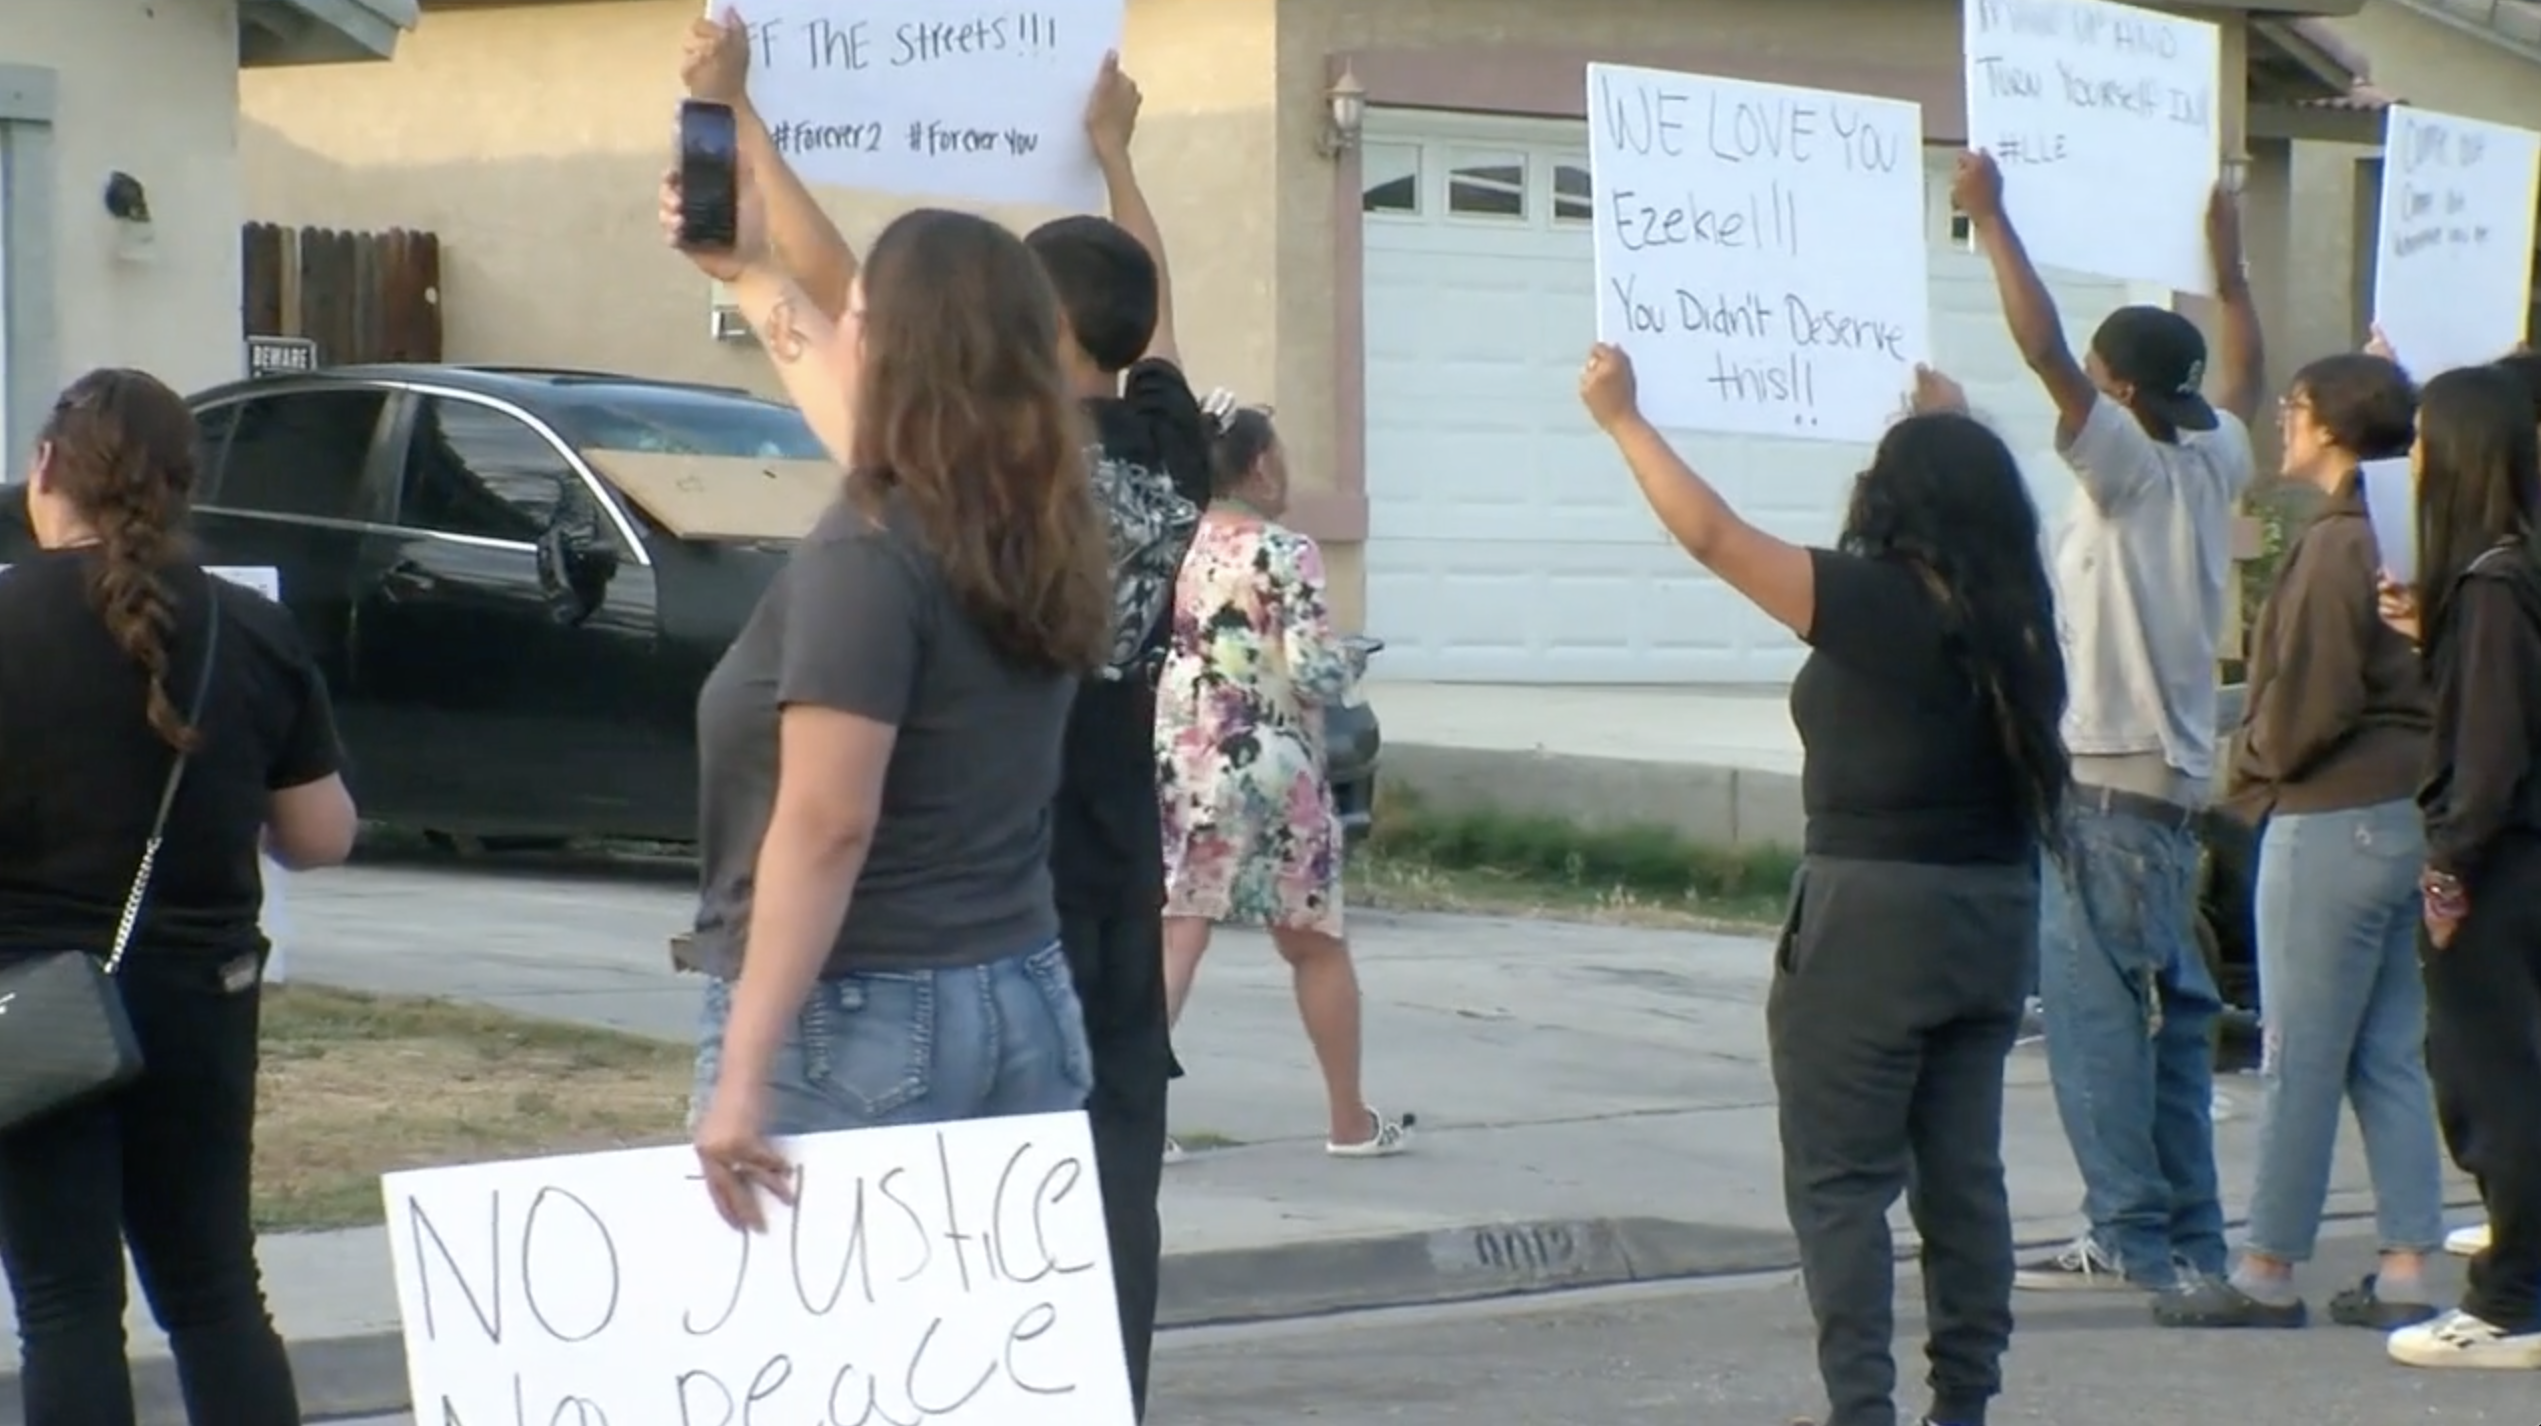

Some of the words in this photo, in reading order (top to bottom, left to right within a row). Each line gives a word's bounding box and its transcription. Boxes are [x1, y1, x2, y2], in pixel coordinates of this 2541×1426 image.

[1601, 74, 1689, 156] WE
[1708, 88, 1817, 163] LOVE
[252, 344, 308, 370] BEWARE
[1610, 272, 1666, 334] You
[1675, 287, 1772, 338] Didn't
[1784, 291, 1906, 362] Deserve
[1706, 349, 1819, 427] this!!
[408, 1185, 620, 1344] NO
